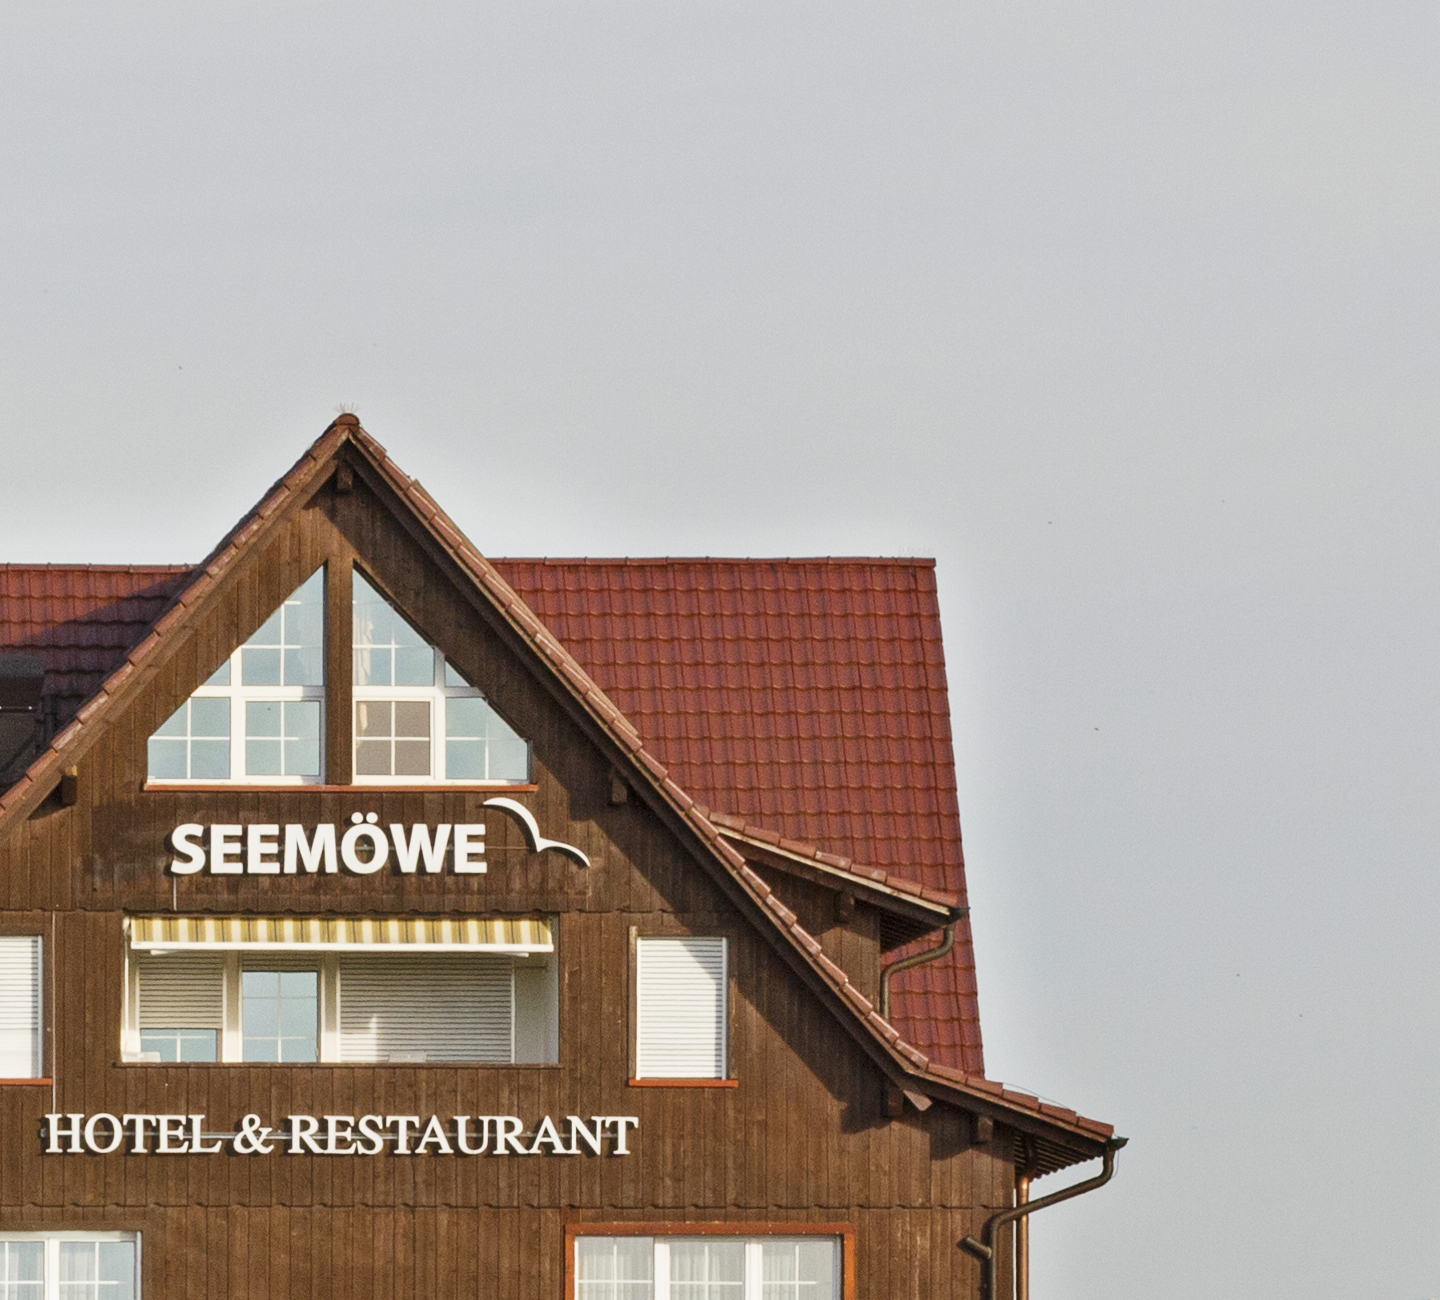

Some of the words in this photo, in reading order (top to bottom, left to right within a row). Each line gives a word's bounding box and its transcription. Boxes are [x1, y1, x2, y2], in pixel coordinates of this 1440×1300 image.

[170, 812, 488, 875] SEEMÖWE
[44, 1113, 221, 1155] HOTEL
[233, 1113, 274, 1155] &
[287, 1114, 640, 1156] RESTAURANT
